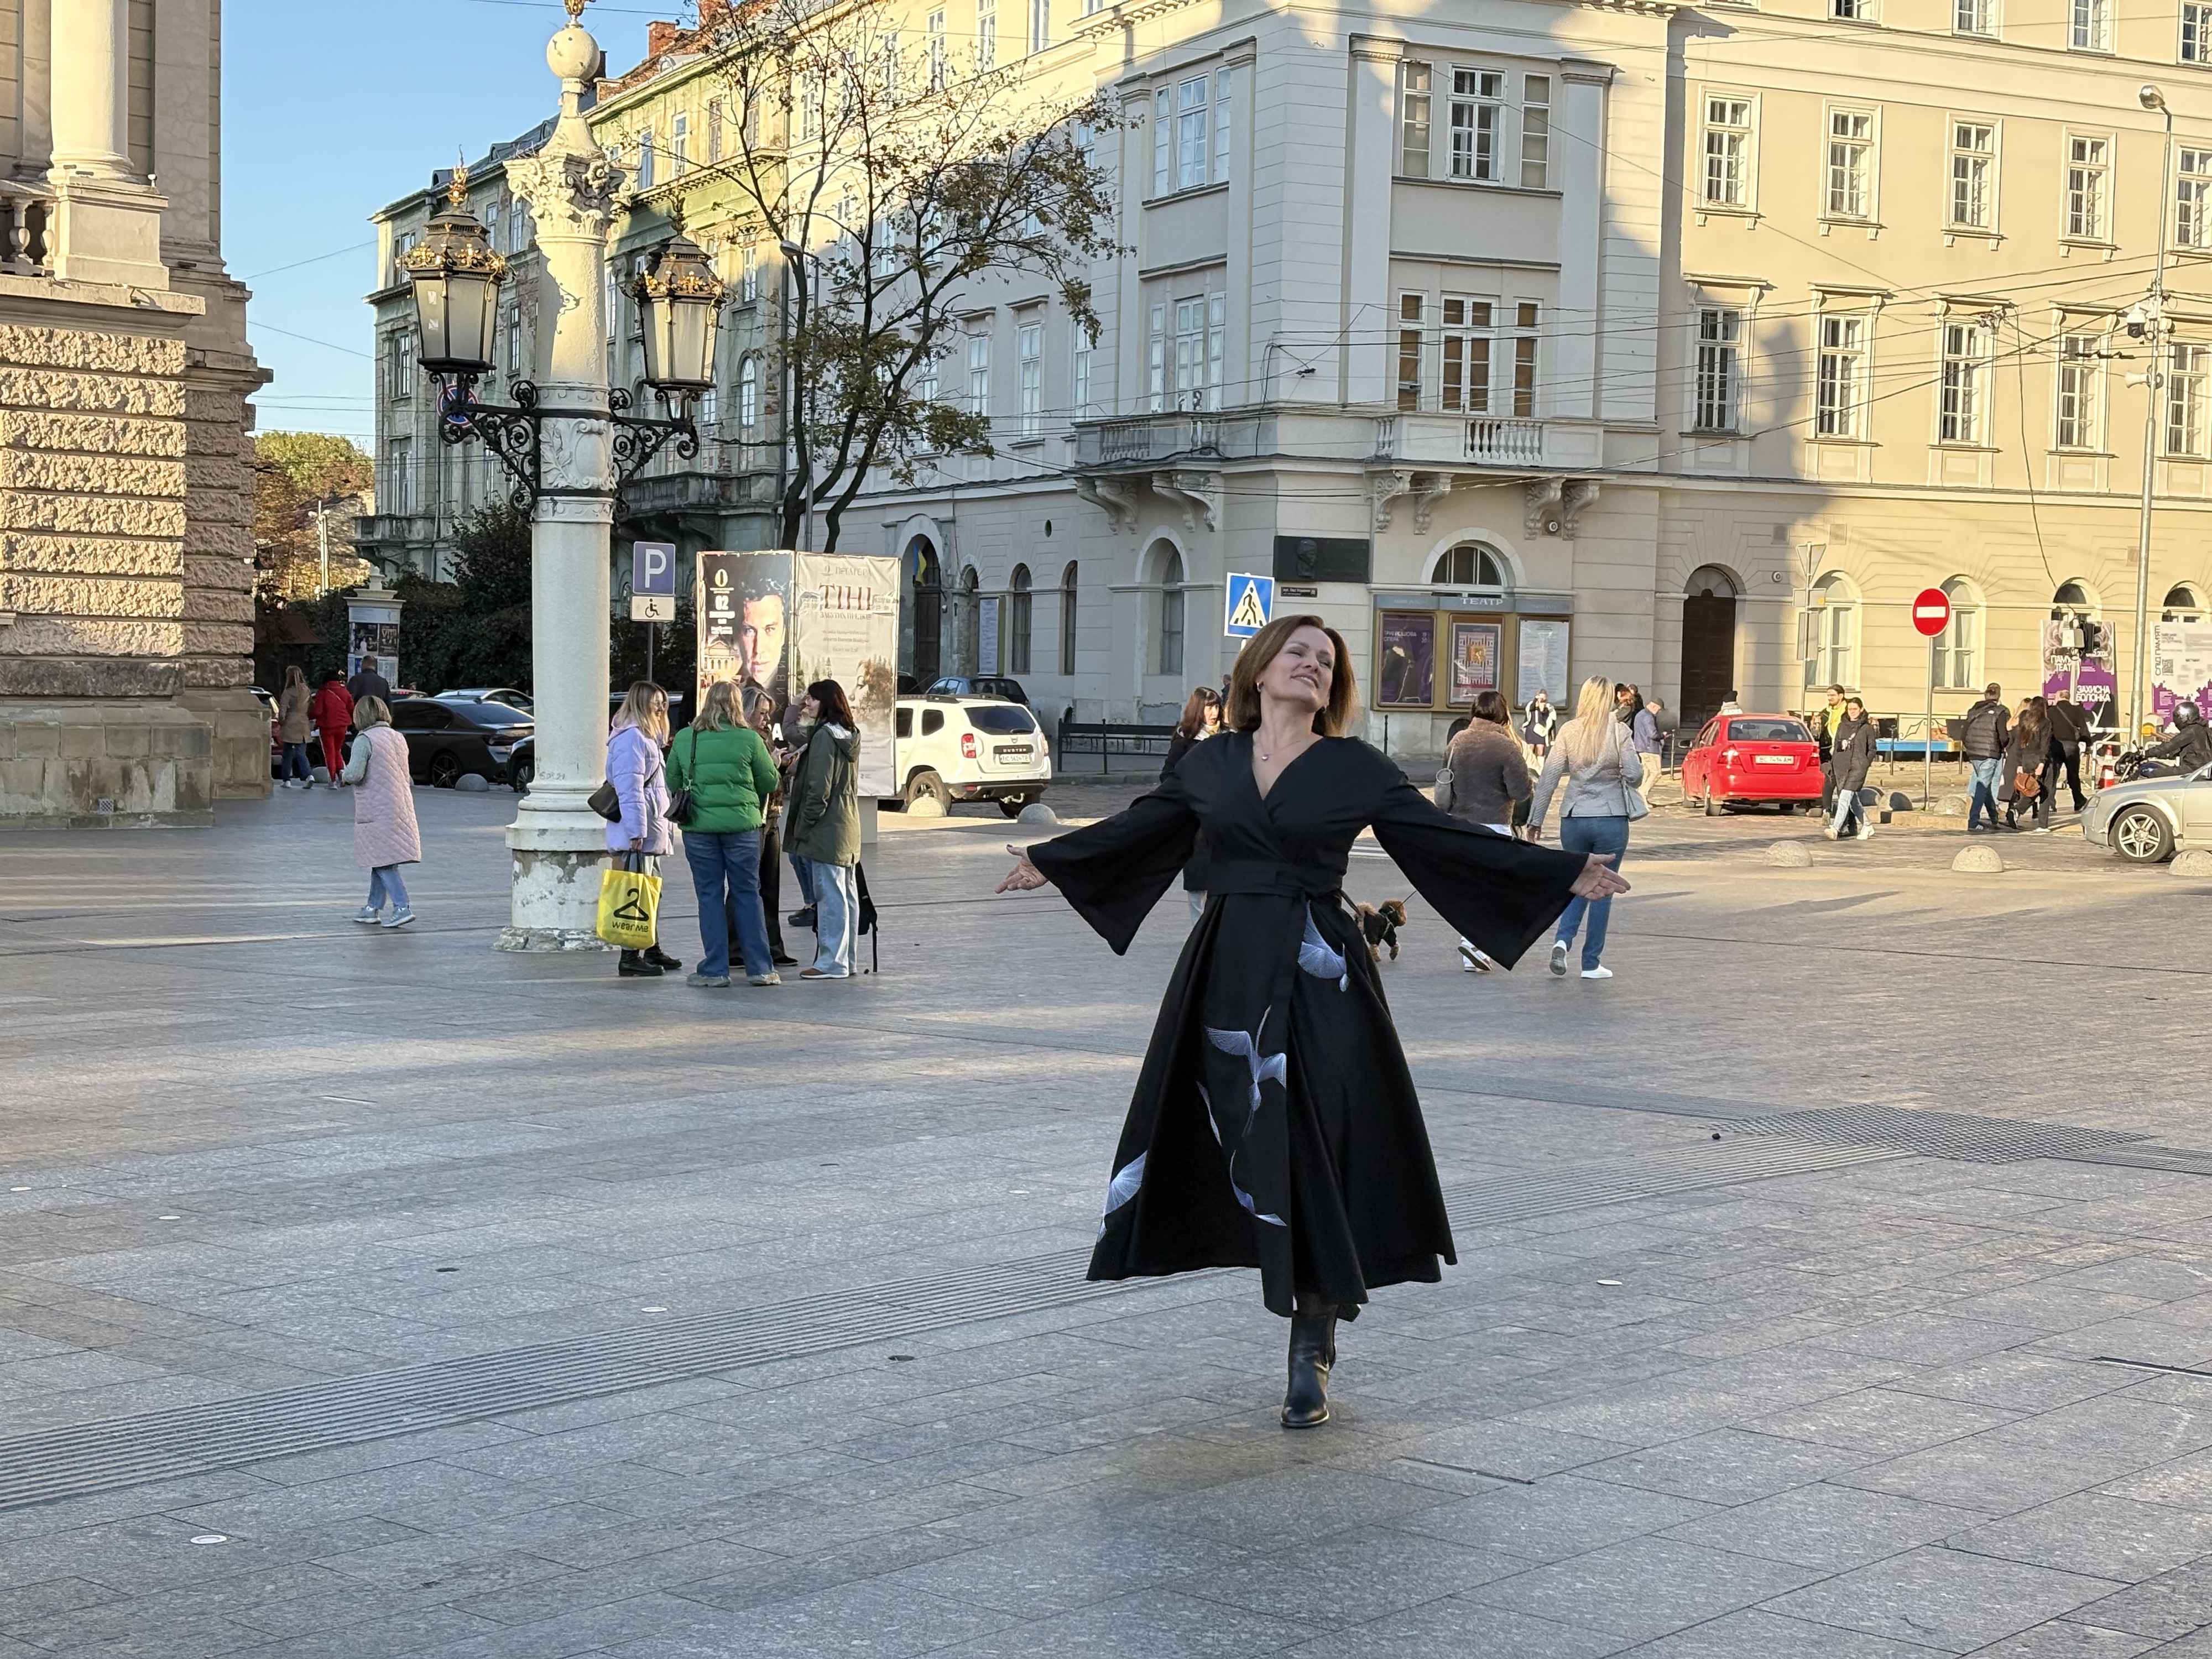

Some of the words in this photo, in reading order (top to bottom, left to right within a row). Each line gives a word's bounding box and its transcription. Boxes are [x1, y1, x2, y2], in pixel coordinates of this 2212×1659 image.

[645, 549, 666, 588] P
[715, 595, 729, 611] 02
[818, 582, 872, 611] ТІНІ
[2077, 685, 2111, 694] ЗАХИСНА
